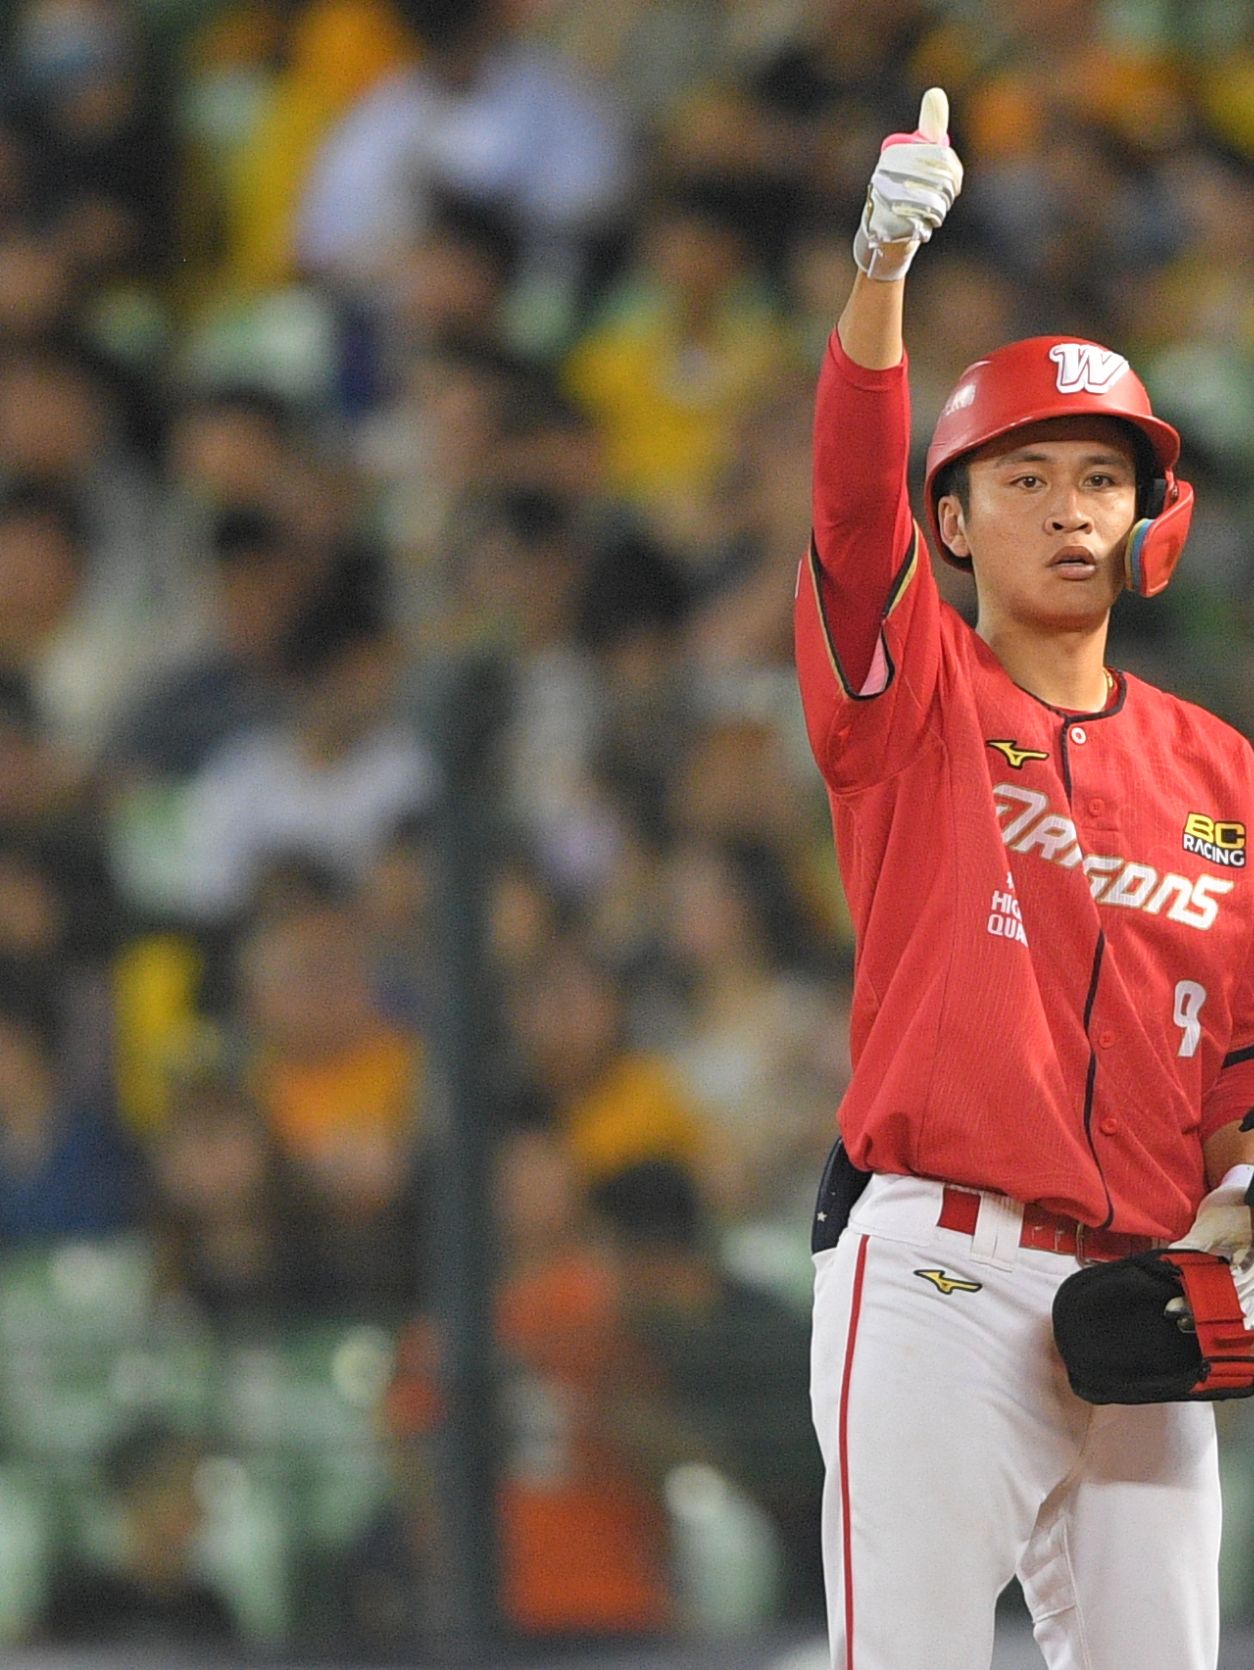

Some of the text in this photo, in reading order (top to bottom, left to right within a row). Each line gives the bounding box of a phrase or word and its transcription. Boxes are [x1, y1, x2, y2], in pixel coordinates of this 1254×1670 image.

[1185, 812, 1245, 849] BC
[1183, 833, 1245, 867] RACING
[1173, 980, 1207, 1057] 9
